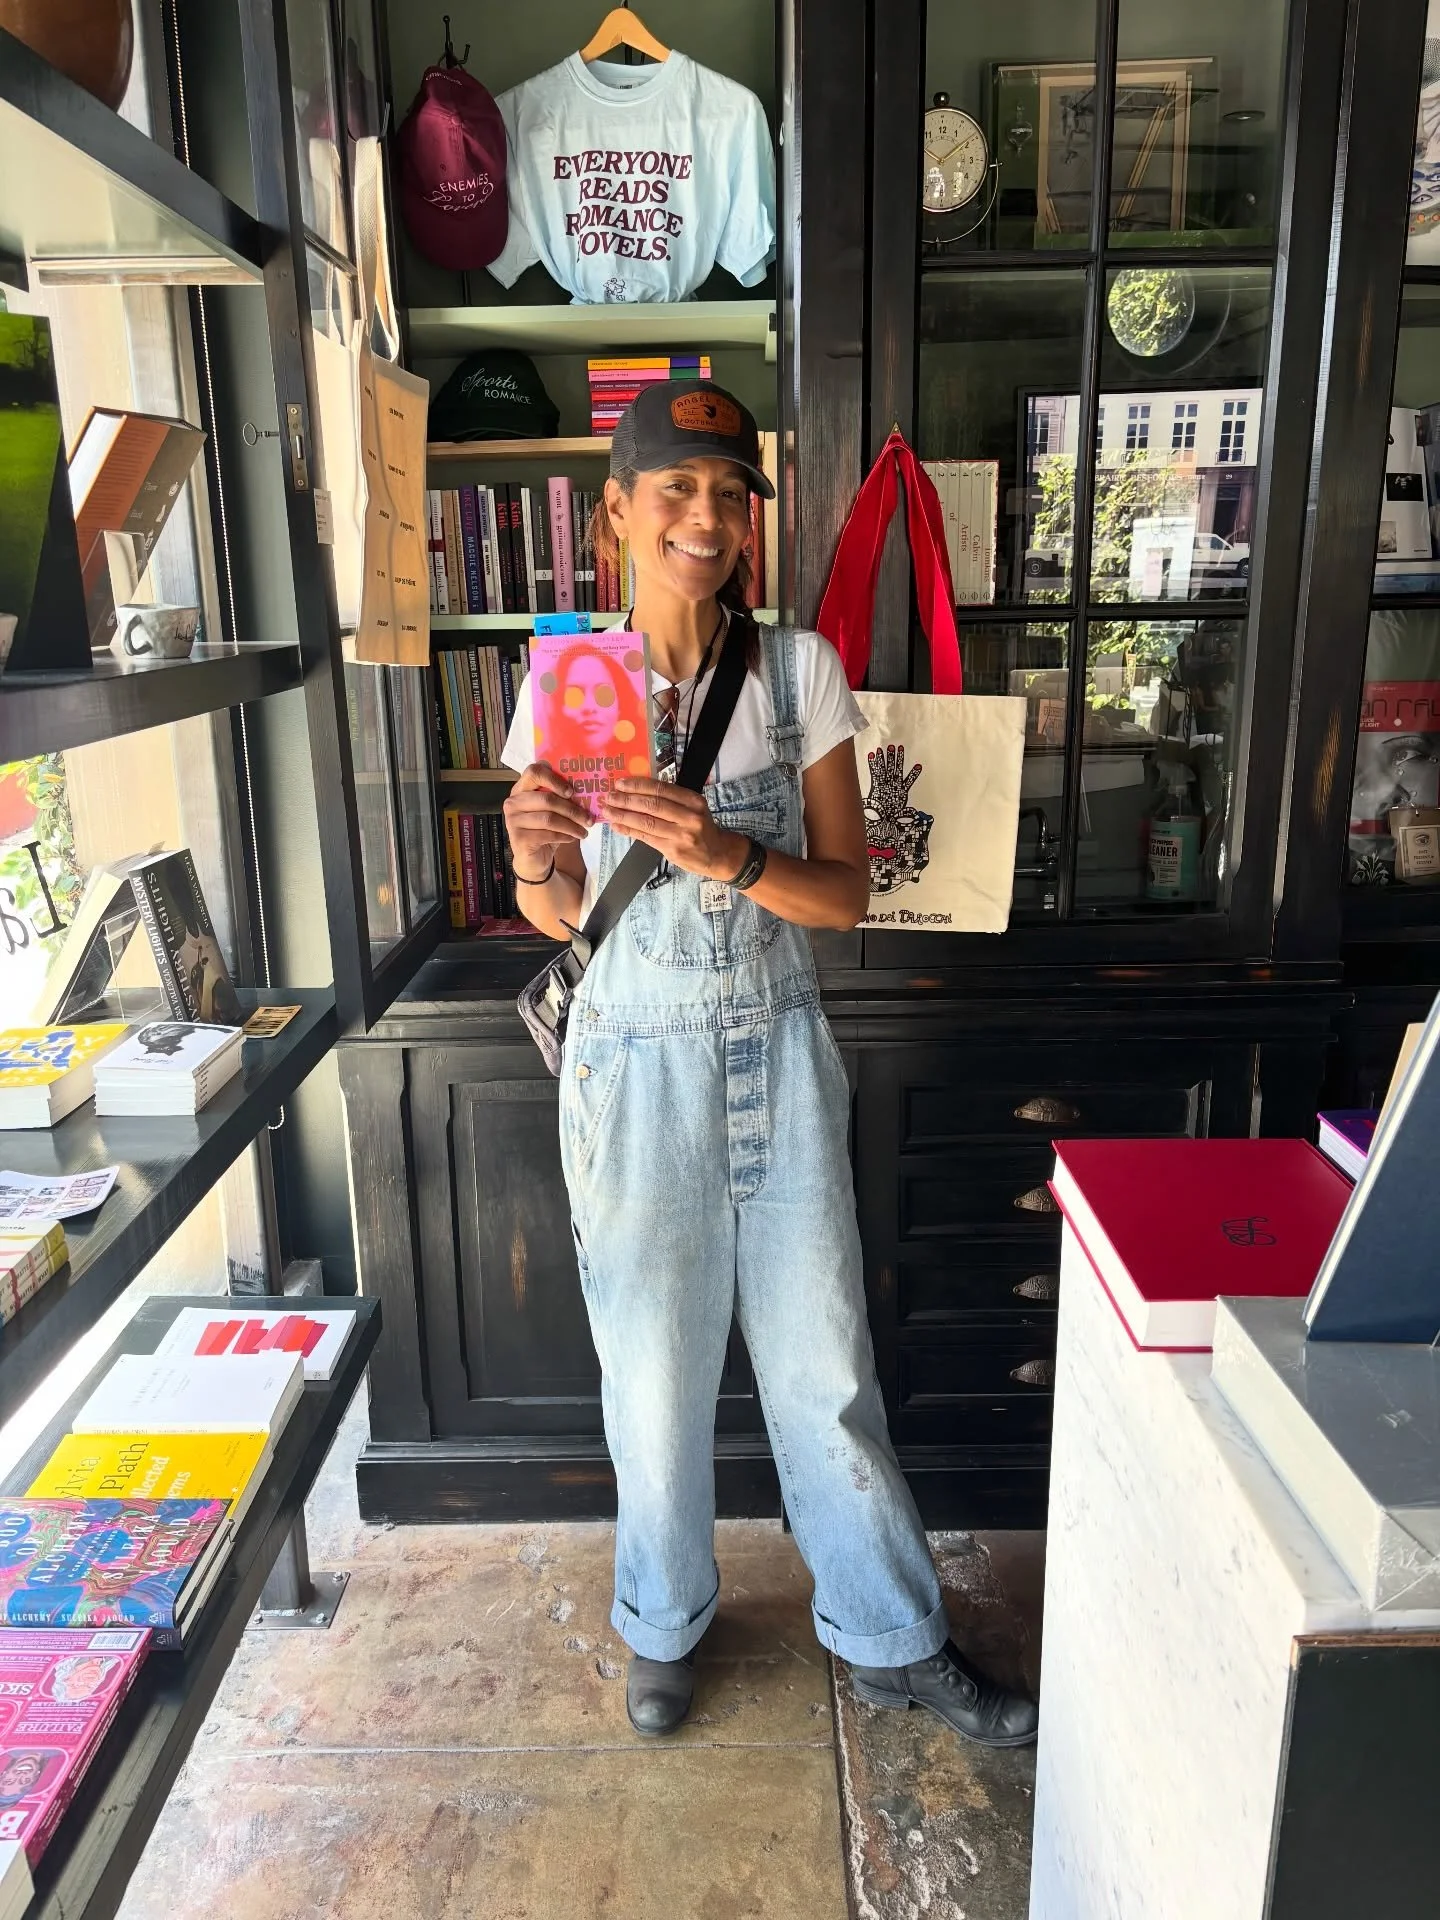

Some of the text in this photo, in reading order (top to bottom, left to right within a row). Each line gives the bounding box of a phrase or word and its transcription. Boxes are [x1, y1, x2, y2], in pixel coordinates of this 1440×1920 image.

[939, 126, 947, 134] 12
[553, 150, 693, 180] EVERYONE
[439, 173, 489, 193] ENEMIES
[579, 177, 669, 205] READS
[462, 193, 475, 202] TO
[565, 204, 683, 238] ROMANCE
[461, 367, 519, 396] Sports
[484, 389, 532, 405] ROMANCE
[676, 395, 711, 408] ANGEL
[497, 503, 509, 530] Kink
[510, 501, 520, 529] Kink
[949, 512, 957, 522] of
[463, 489, 479, 601] LIKE LOVE MAGGIE NELSON
[556, 525, 565, 550] gillian
[961, 523, 969, 552] Artists
[973, 534, 981, 562] Calvin
[559, 550, 567, 585] anderson
[468, 650, 477, 671] TENDER
[472, 679, 480, 690] THE
[560, 752, 625, 774] colored
[463, 819, 471, 847] CREATION
[1150, 845, 1178, 857] EANER
[184, 856, 209, 928] LENA VALENCIA
[712, 893, 727, 902] Lee
[132, 876, 167, 965] MYSTERY LIGHTS
[147, 872, 201, 1022] YSTERY LIGHTS
[162, 968, 184, 1022] ENA VALENCIA
[54, 1456, 101, 1498] ylvia
[98, 1442, 149, 1492] Plath
[15, 1537, 44, 1556] OF
[30, 1511, 97, 1583] ALCHEMY
[72, 1545, 95, 1572] CREATIVE
[91, 1516, 114, 1544] PRACTICE
[98, 1530, 119, 1556] INSPIRED
[101, 1514, 162, 1579] SULEIKA
[138, 1518, 191, 1576] JAOUAD
[12, 1613, 51, 1621] ALCHEMY
[102, 1614, 135, 1622] JAOUAD
[15, 1722, 84, 1733] FAILURE
